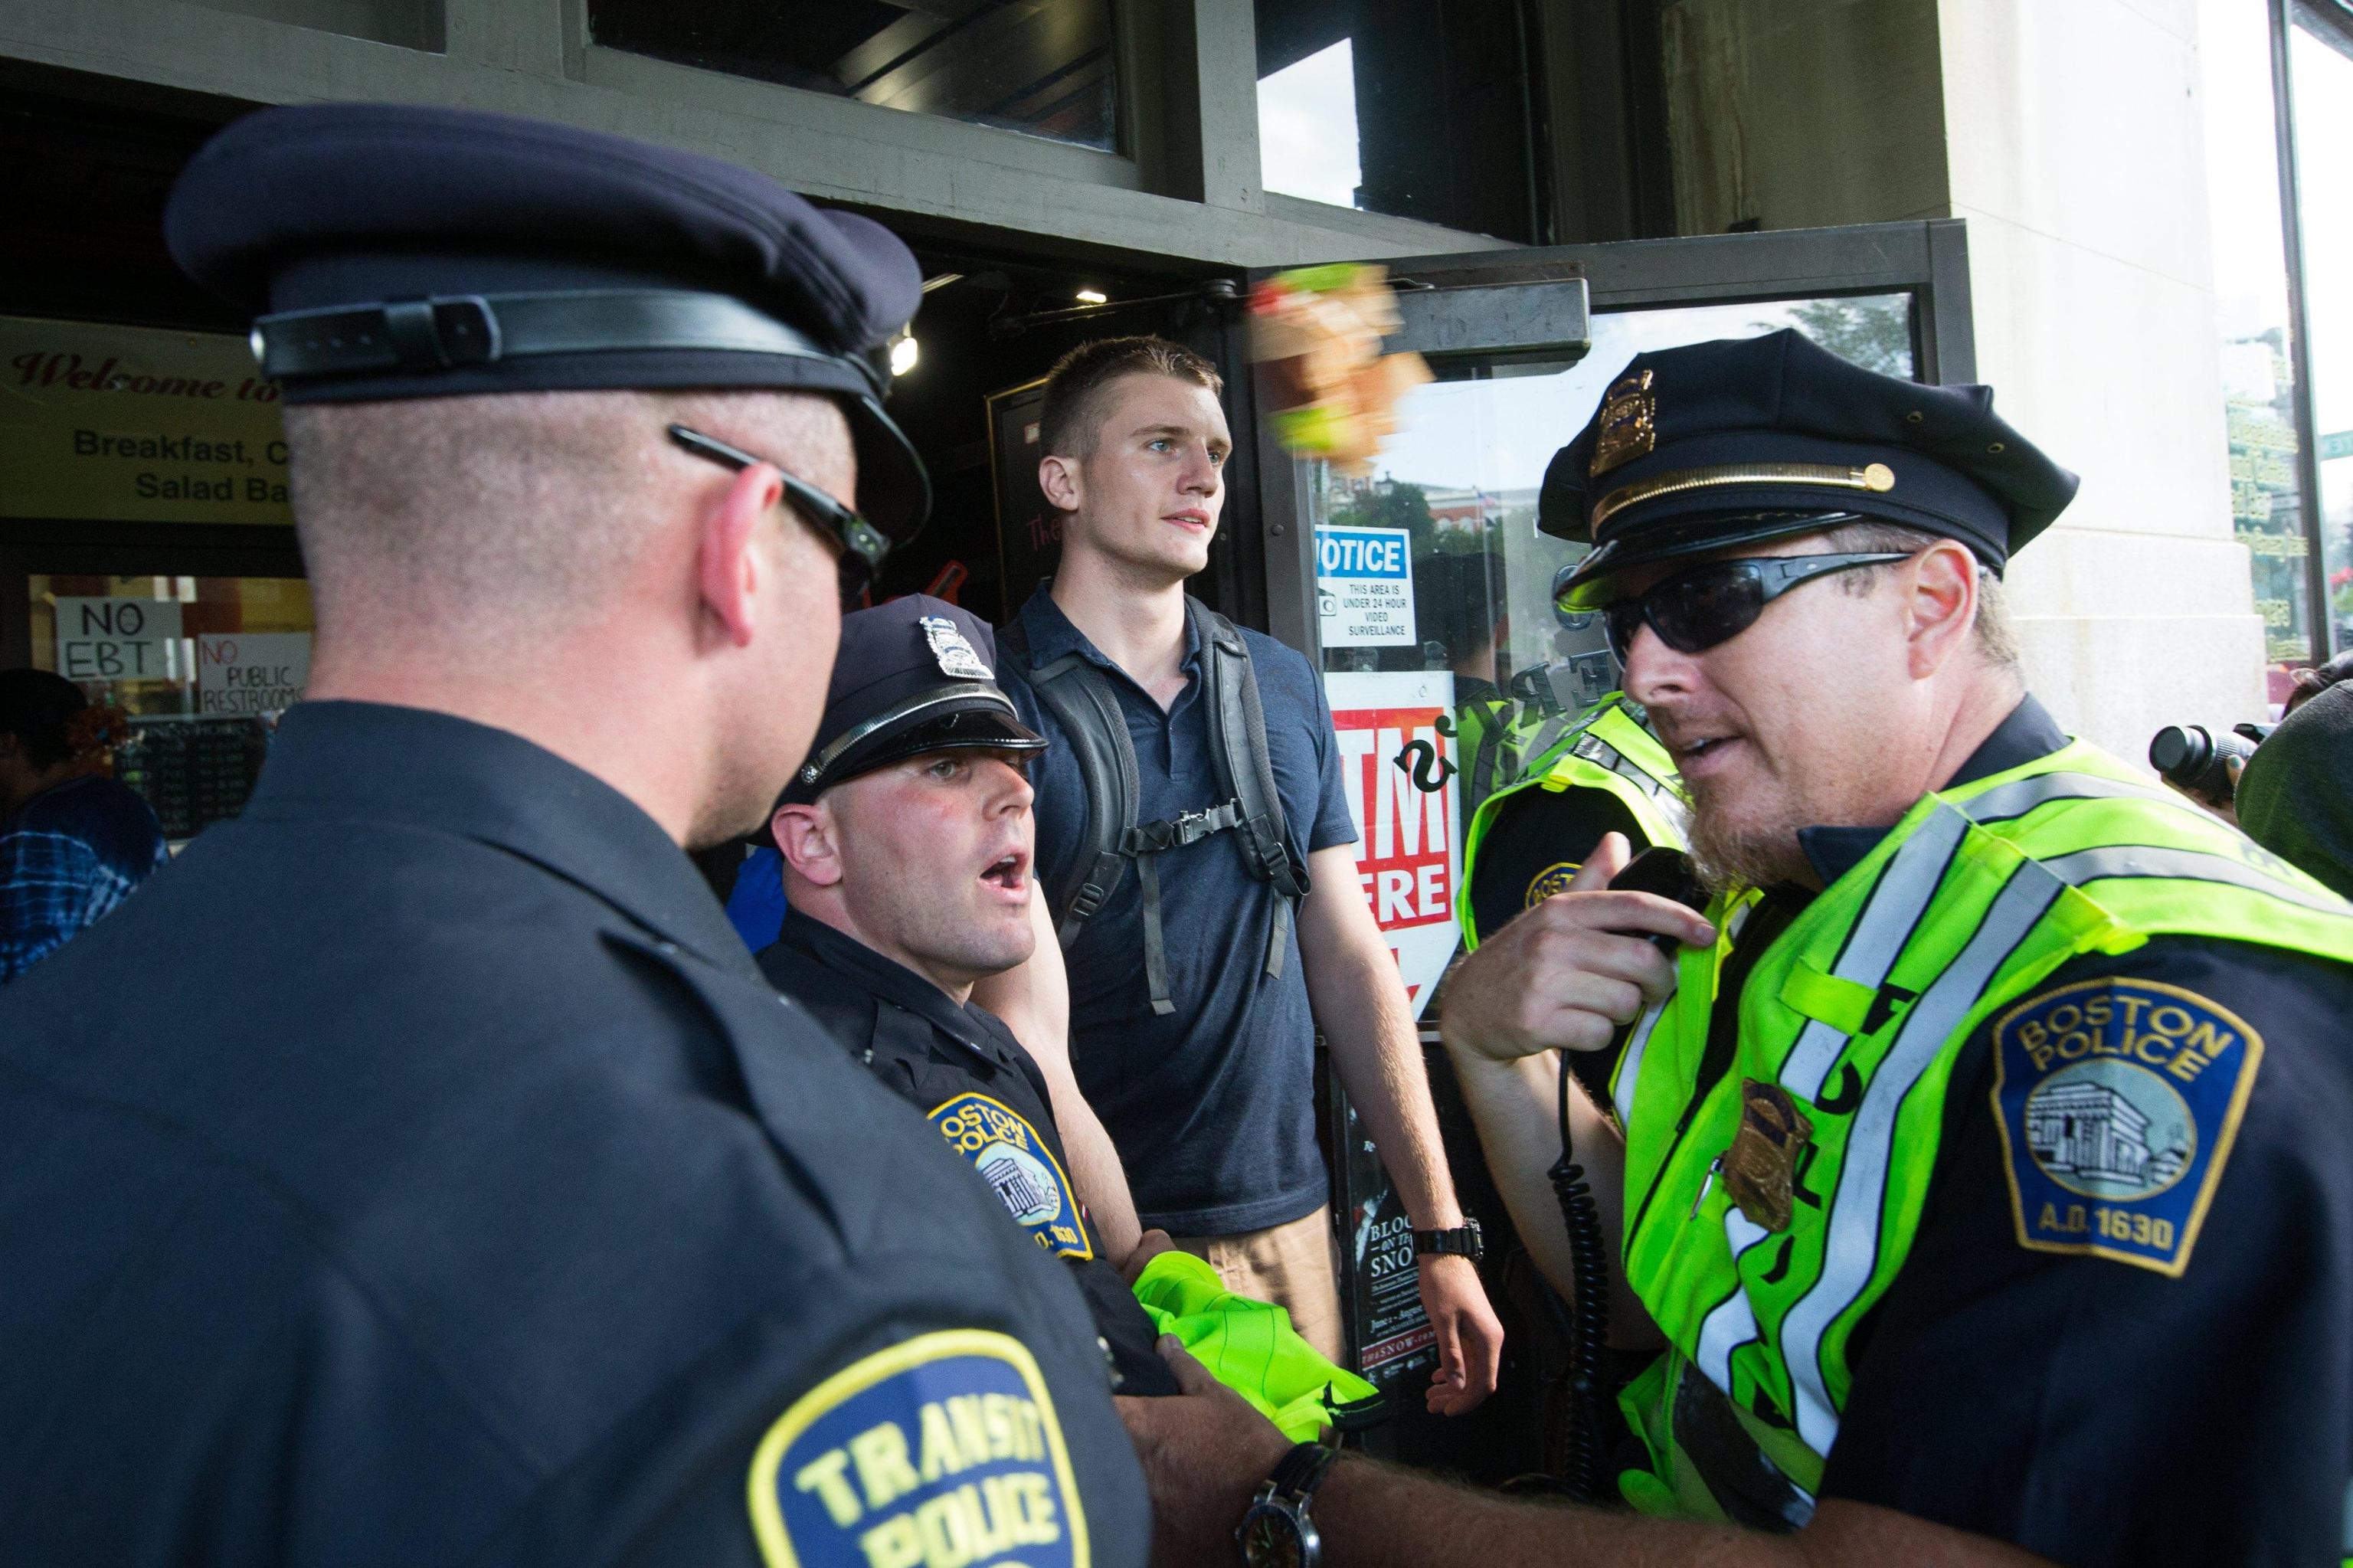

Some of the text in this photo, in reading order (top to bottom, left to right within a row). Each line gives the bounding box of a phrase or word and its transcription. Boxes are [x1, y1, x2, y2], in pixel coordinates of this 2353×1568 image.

[11, 351, 281, 403] Welcome to
[74, 429, 255, 466] Breakfast,
[136, 471, 233, 501] Salad
[1343, 597, 1407, 609] UNDER 24 HOUR
[1350, 584, 1400, 595] THIS AREA IS
[81, 602, 145, 636] NO
[1349, 625, 1406, 637] SURVEILLANCE
[1365, 612, 1389, 622] VIDEO
[66, 640, 152, 679] EBT
[202, 640, 238, 665] NO
[227, 666, 292, 687] PUBLIC
[2017, 995, 2234, 1060] BOSTON
[2029, 1028, 2211, 1082] POLICE
[940, 1103, 1026, 1138] OSTON
[2038, 1201, 2175, 1251] A.D. 1630
[794, 1392, 1046, 1528] TRANSIT
[860, 1471, 1060, 1568] POLICE
